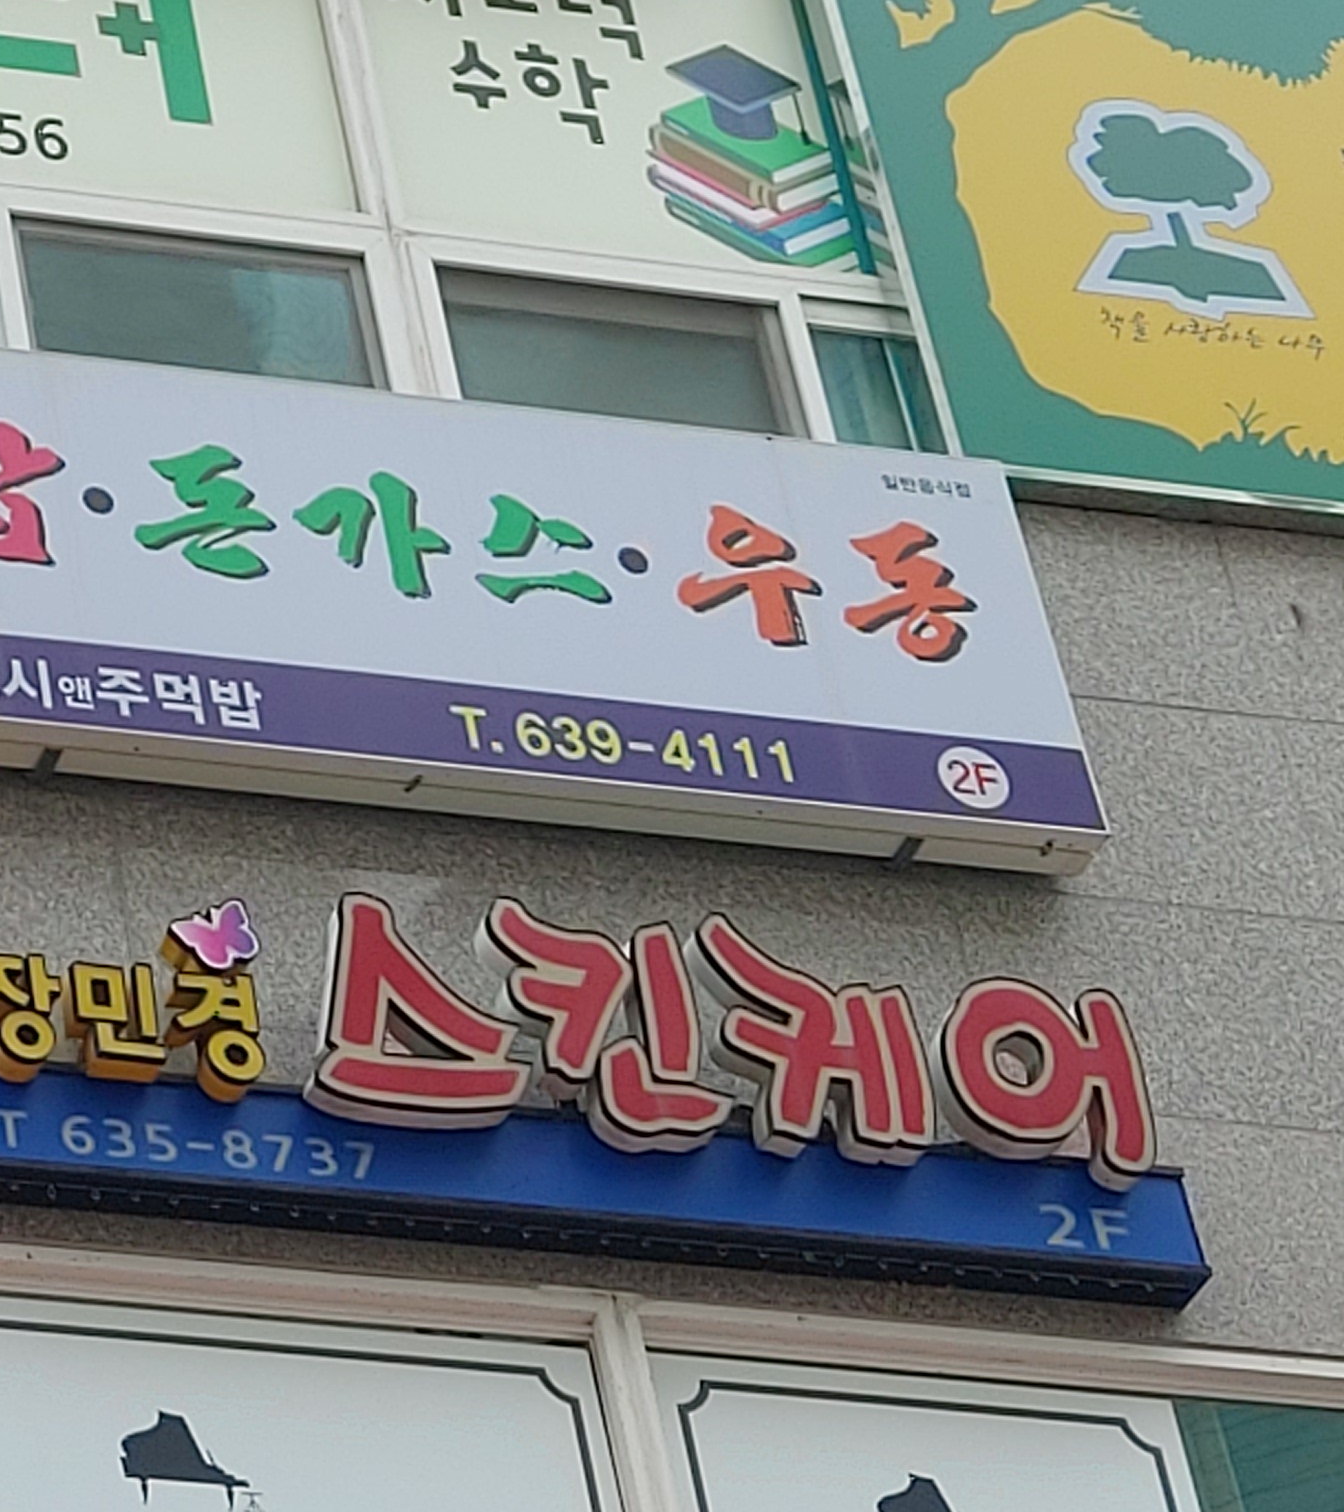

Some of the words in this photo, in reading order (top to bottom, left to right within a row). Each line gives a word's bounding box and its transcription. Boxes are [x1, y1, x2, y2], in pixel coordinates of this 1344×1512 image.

[451, 39, 610, 145] 수학
[946, 758, 1001, 797] 2F
[318, 892, 1157, 1180] 스킨케어
[62, 1115, 376, 1180] 635-8737
[1038, 1203, 1131, 1251] 2F
